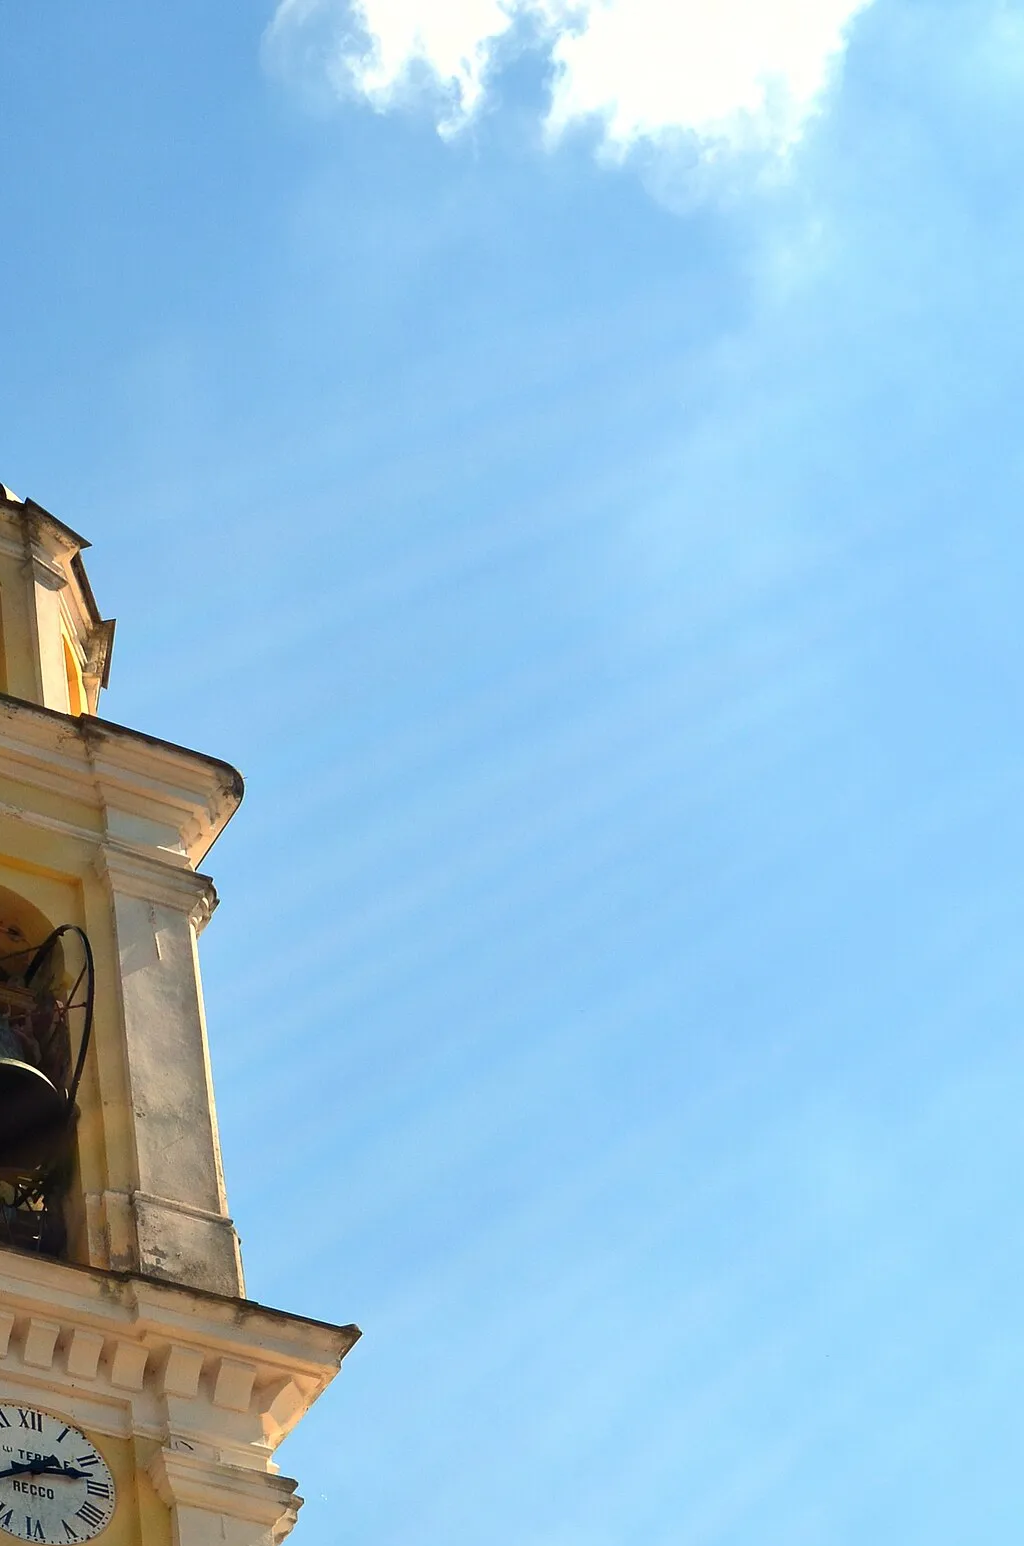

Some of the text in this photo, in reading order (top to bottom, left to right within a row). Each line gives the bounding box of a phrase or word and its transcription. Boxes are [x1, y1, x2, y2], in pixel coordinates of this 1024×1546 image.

[18, 1409, 44, 1433] XII
[56, 1428, 70, 1443] I
[76, 1454, 99, 1468] II
[13, 1480, 55, 1500] RECCO
[87, 1480, 110, 1499] III
[75, 1501, 106, 1528] IIII
[25, 1516, 46, 1539] VI
[61, 1519, 80, 1540] V
